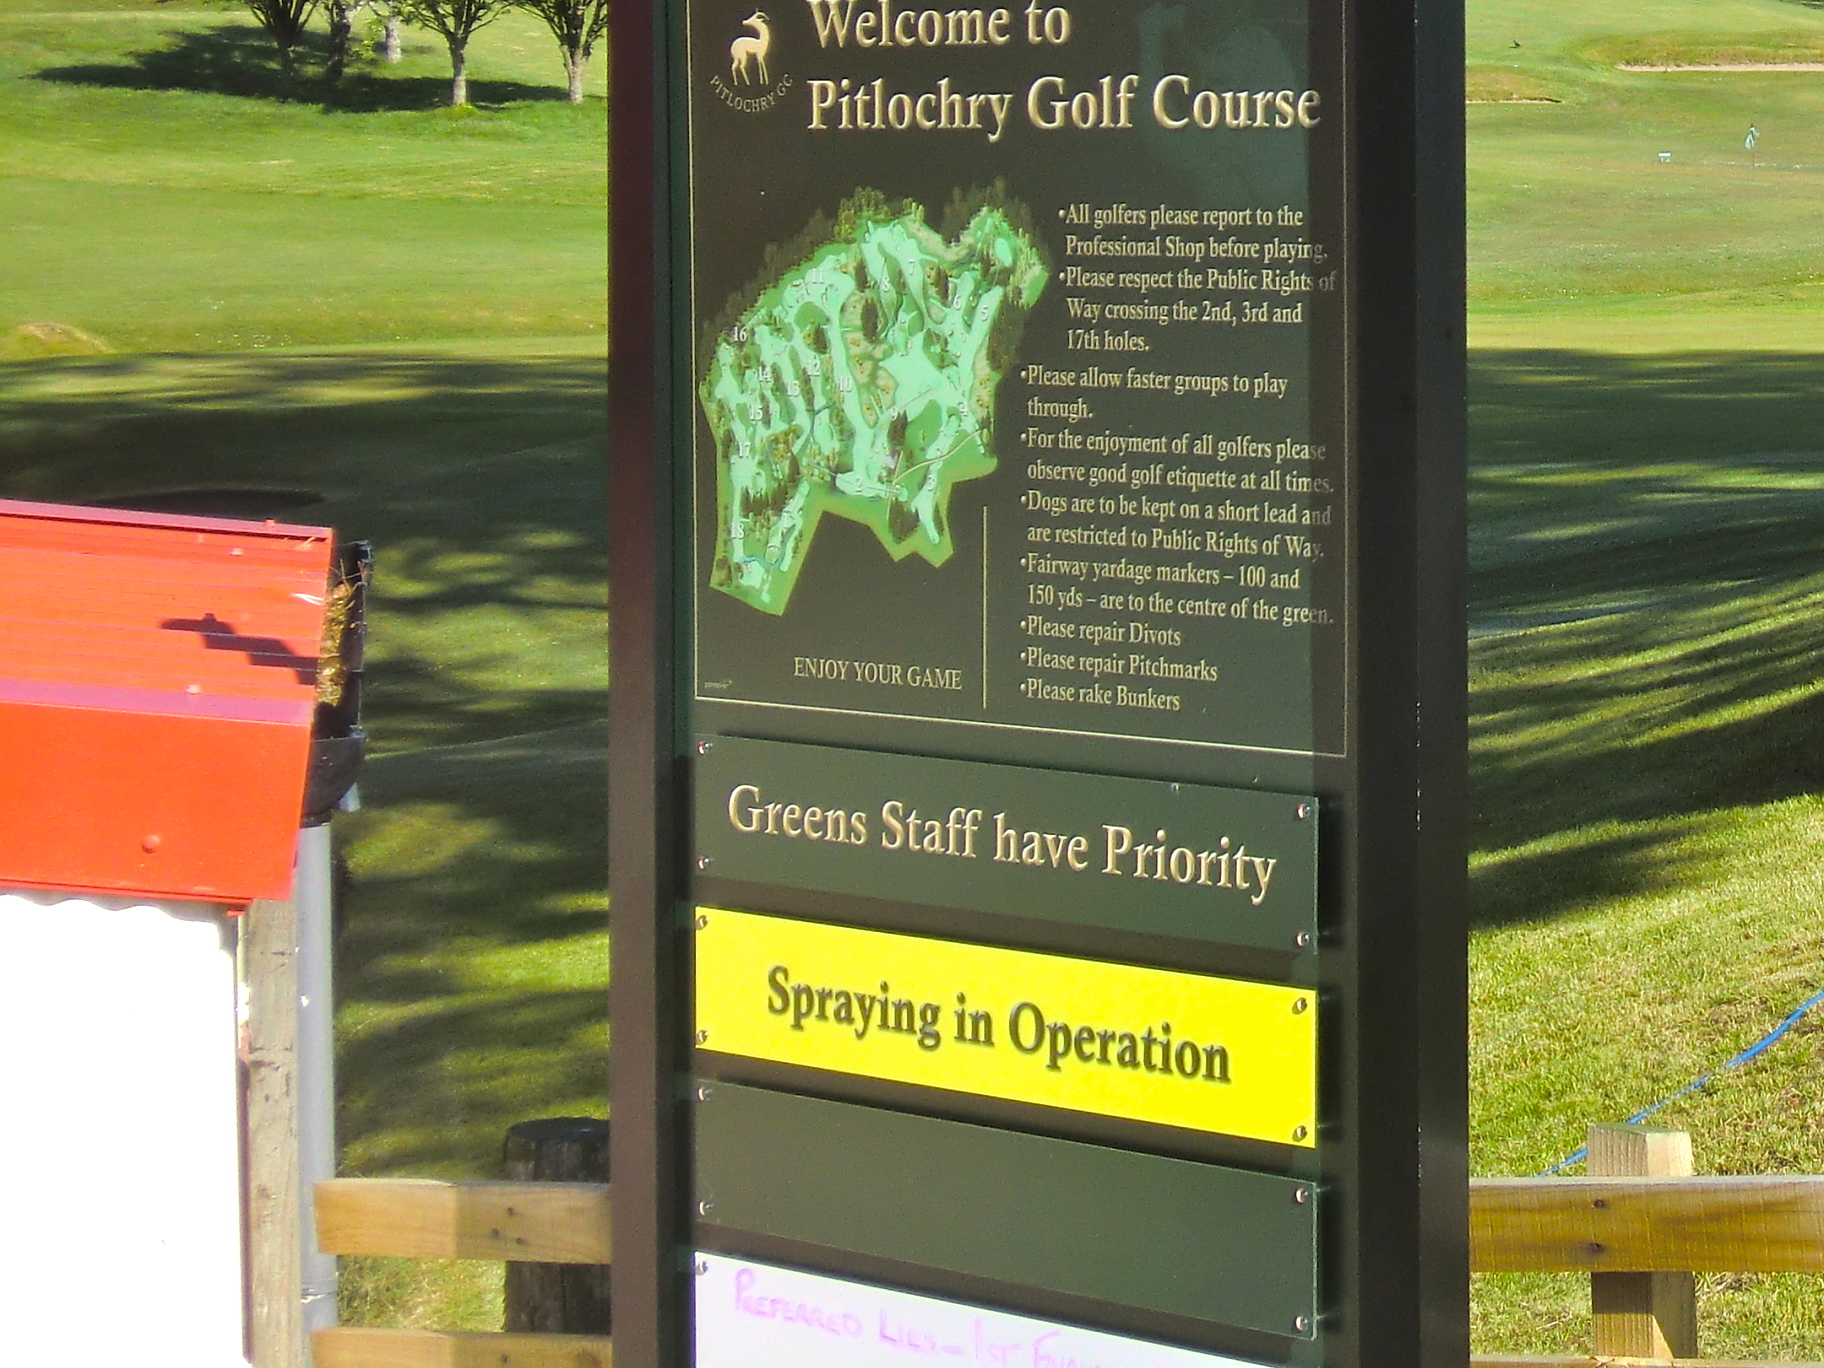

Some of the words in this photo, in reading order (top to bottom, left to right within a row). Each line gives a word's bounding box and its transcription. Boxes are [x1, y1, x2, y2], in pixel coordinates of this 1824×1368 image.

[710, 75, 775, 113] PITLOCHRY
[776, 73, 793, 96] GC
[806, 76, 1013, 144] Pitlochry
[1027, 74, 1140, 130] Golf
[1152, 74, 1322, 130] Course
[1065, 203, 1090, 225] All
[1094, 204, 1147, 229] golfers
[1150, 204, 1199, 230] please
[1202, 207, 1251, 231] report
[1256, 208, 1272, 225] to
[1277, 205, 1303, 225] the
[1065, 235, 1160, 257] Professional
[1165, 236, 1205, 262] Shop
[1209, 237, 1260, 258] before
[1263, 238, 1328, 264] playing.
[908, 259, 915, 275] 7
[1065, 266, 1114, 288] Please
[1118, 271, 1173, 293] respect
[1177, 268, 1202, 289] the
[1206, 268, 1257, 291] Public
[1261, 270, 1314, 296] Rights
[1319, 271, 1336, 291] of
[882, 276, 890, 291] 8
[954, 294, 961, 310] 6
[982, 305, 988, 321] 5
[1066, 298, 1101, 323] Way
[1105, 299, 1169, 325] crossing
[1173, 300, 1198, 320] the
[1201, 300, 1237, 327] 2nd,
[1242, 301, 1268, 323] 3rd
[1272, 301, 1303, 323] and
[734, 326, 747, 342] 16
[1067, 329, 1100, 350] 17th
[1104, 330, 1150, 351] holes.
[758, 367, 772, 382] 14
[808, 360, 820, 376] 12
[1026, 364, 1075, 386] Please
[1080, 366, 1122, 388] allow
[1126, 367, 1171, 390] faster
[1175, 374, 1229, 396] groups
[1233, 374, 1249, 392] to
[1253, 372, 1288, 399] play
[787, 381, 800, 396] 13
[750, 404, 763, 420] 15
[891, 406, 898, 420] 9
[1028, 397, 1093, 423] through.
[738, 442, 750, 458] 17
[1027, 427, 1055, 448] For
[1058, 428, 1082, 449] the
[1086, 430, 1167, 456] enjoyment
[1171, 433, 1190, 455] of
[1193, 434, 1213, 456] all
[1217, 435, 1272, 461] golfers
[1276, 438, 1326, 463] please
[1028, 459, 1085, 481] observe
[1089, 463, 1127, 487] good
[1131, 464, 1164, 489] golf
[1166, 465, 1236, 492] etiquette
[1241, 472, 1256, 490] at
[1261, 470, 1281, 491] all
[1027, 490, 1067, 516] Dogs
[1071, 498, 1094, 513] are
[1098, 495, 1115, 515] to
[1119, 495, 1137, 516] be
[1141, 495, 1175, 522] kept
[1179, 502, 1200, 519] on
[1204, 505, 1213, 520] a
[1217, 499, 1259, 522] short
[1264, 501, 1296, 523] lead
[1302, 505, 1331, 525] and
[731, 523, 744, 539] 18
[1028, 526, 1051, 542] are
[1054, 524, 1127, 546] restricted
[1131, 528, 1147, 547] to
[1151, 528, 1201, 551] Public
[1205, 530, 1259, 558] Rights
[1262, 535, 1281, 555] of
[1027, 552, 1088, 578] Fairway
[1092, 557, 1152, 585] yardage
[1156, 562, 1220, 585] markers
[1238, 565, 1266, 587] 100
[1270, 569, 1300, 588] and
[1028, 584, 1054, 605] 150
[1057, 586, 1082, 611] yds
[1100, 594, 1123, 610] are
[1127, 593, 1144, 611] to
[1149, 592, 1173, 613] the
[1177, 598, 1226, 617] centre
[1230, 597, 1249, 618] of
[1253, 599, 1278, 620] the
[1026, 614, 1075, 638] Please
[1079, 620, 1125, 646] repair
[1128, 622, 1181, 646] Divots
[794, 657, 849, 680] ENJOY
[853, 661, 903, 686] YOUR
[907, 666, 963, 690] GAME
[1026, 646, 1075, 670] Please
[1079, 653, 1125, 678] repair
[1128, 654, 1218, 682] Pitchmarks
[1026, 678, 1075, 702] Please
[1079, 684, 1112, 704] rake
[1116, 685, 1181, 711] Bunkers
[728, 783, 868, 845] Greens
[881, 800, 984, 859] Staff
[993, 812, 1089, 872] have
[1101, 824, 1278, 906] Priority
[767, 964, 941, 1050] Spraying
[953, 993, 995, 1048] in
[1008, 1001, 1231, 1083] Operation
